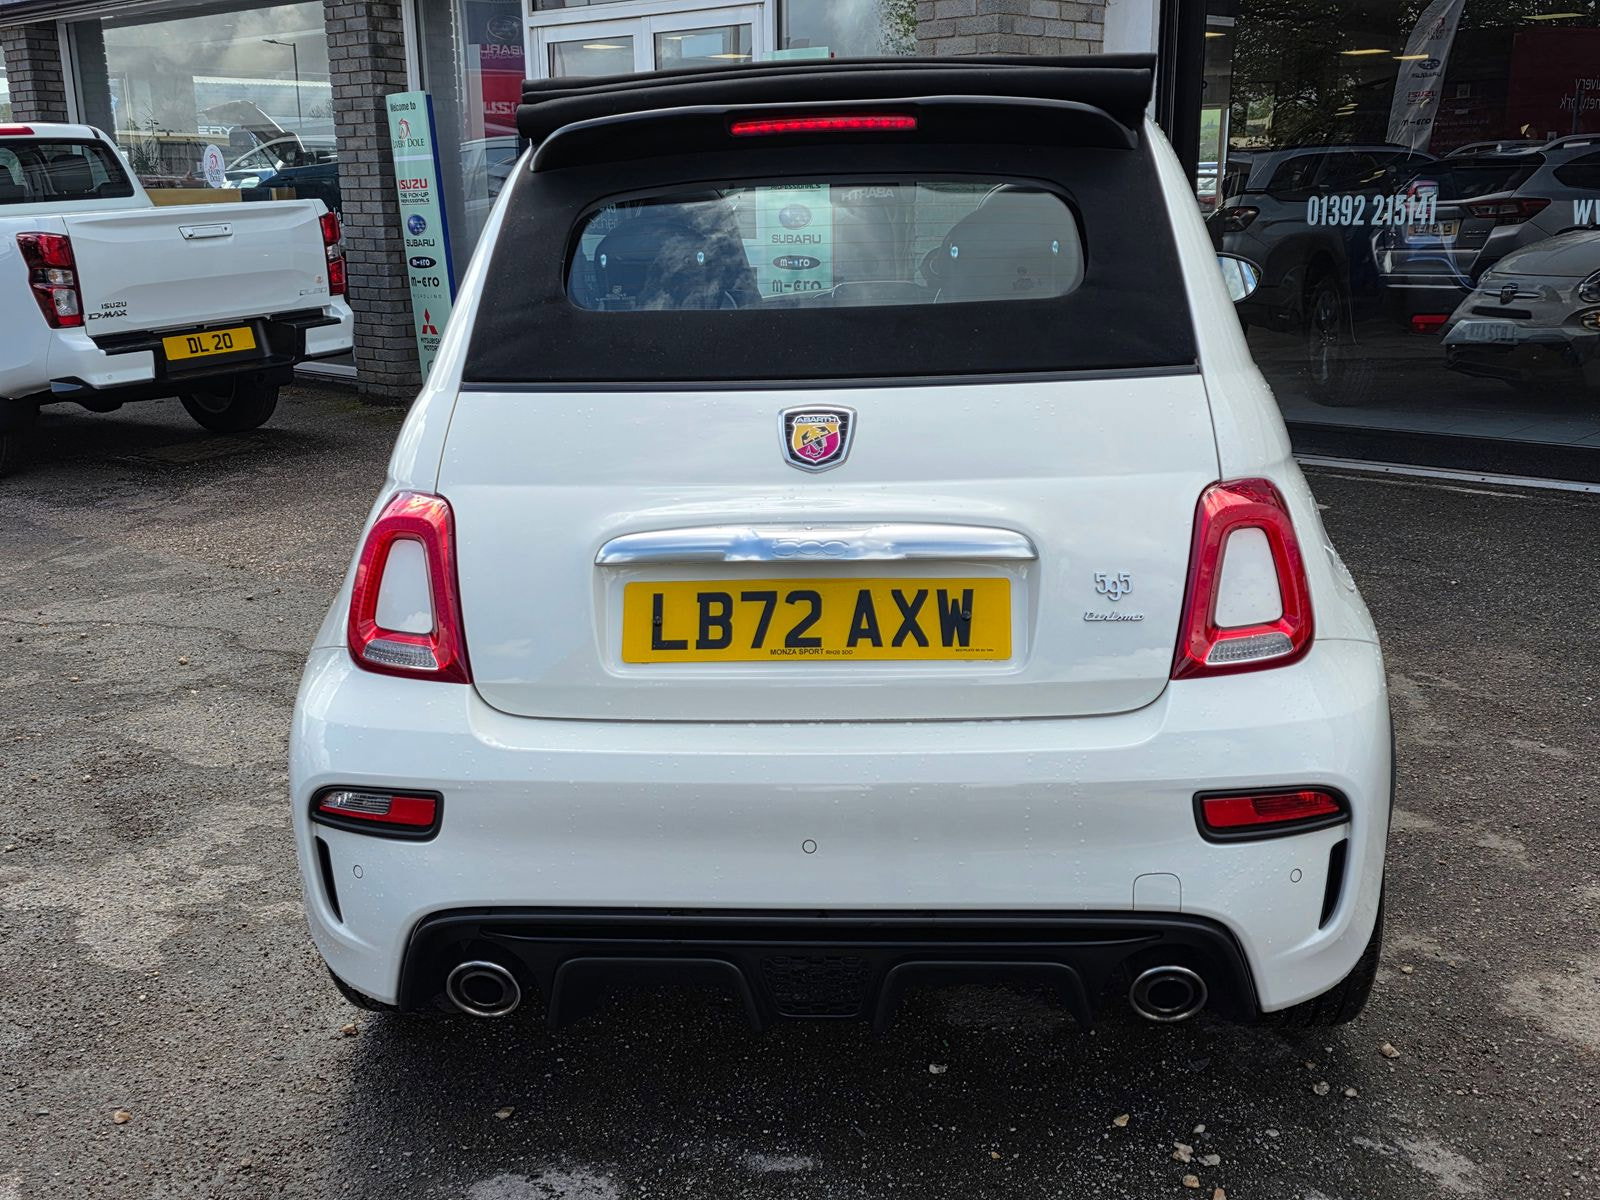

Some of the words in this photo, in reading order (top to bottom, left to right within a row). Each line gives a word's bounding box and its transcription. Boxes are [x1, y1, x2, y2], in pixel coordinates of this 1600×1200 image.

[389, 103, 409, 113] Welcome
[410, 101, 416, 111] to
[398, 178, 428, 190] ISUZU
[1307, 195, 1366, 226] 01392
[1371, 194, 1437, 225] 215141
[406, 239, 435, 247] SUBARU
[771, 234, 821, 244] SUBARU
[780, 258, 810, 267] m-ro
[101, 301, 127, 309] ISUZU
[88, 310, 127, 320] D-MAX
[186, 336, 209, 354] DL
[214, 332, 234, 351] 20
[1094, 571, 1132, 602] 595
[651, 590, 823, 651] LB72
[847, 588, 974, 648] AXW
[799, 648, 824, 656] SPORT
